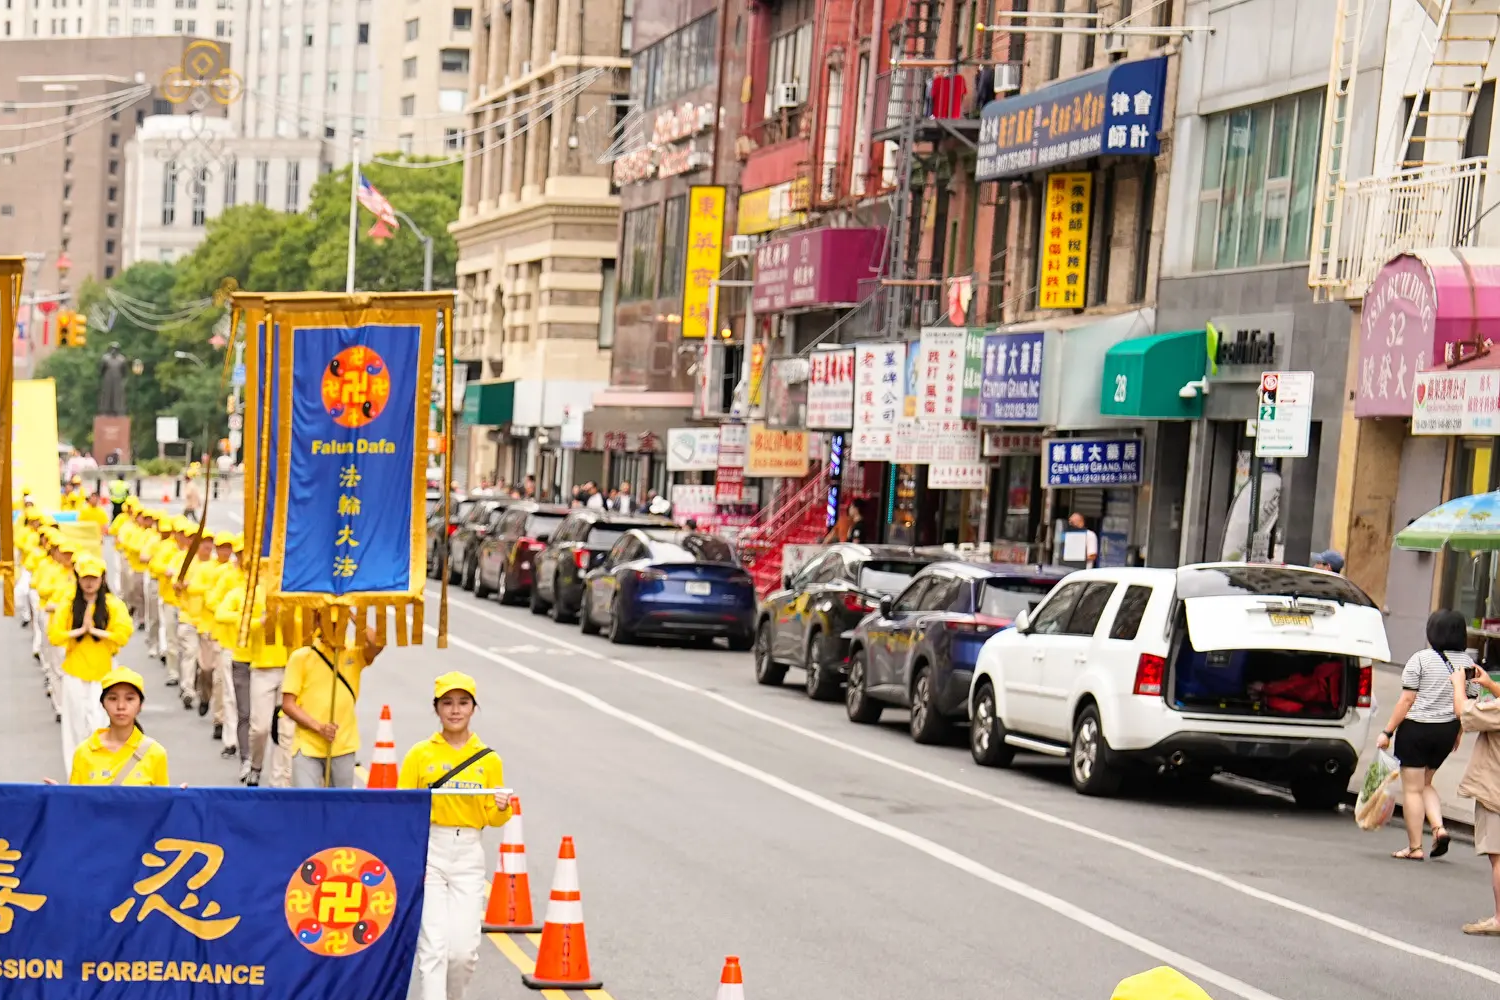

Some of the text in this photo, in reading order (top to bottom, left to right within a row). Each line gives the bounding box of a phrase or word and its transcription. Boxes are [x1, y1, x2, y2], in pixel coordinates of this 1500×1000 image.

[1386, 271, 1432, 334] BUILDING
[1386, 311, 1407, 348] 32
[311, 437, 396, 456] Falun Dafa
[1051, 462, 1090, 475] CENTURY
[332, 463, 363, 578] 法輪大法
[81, 960, 266, 987] FORBEARANCE
